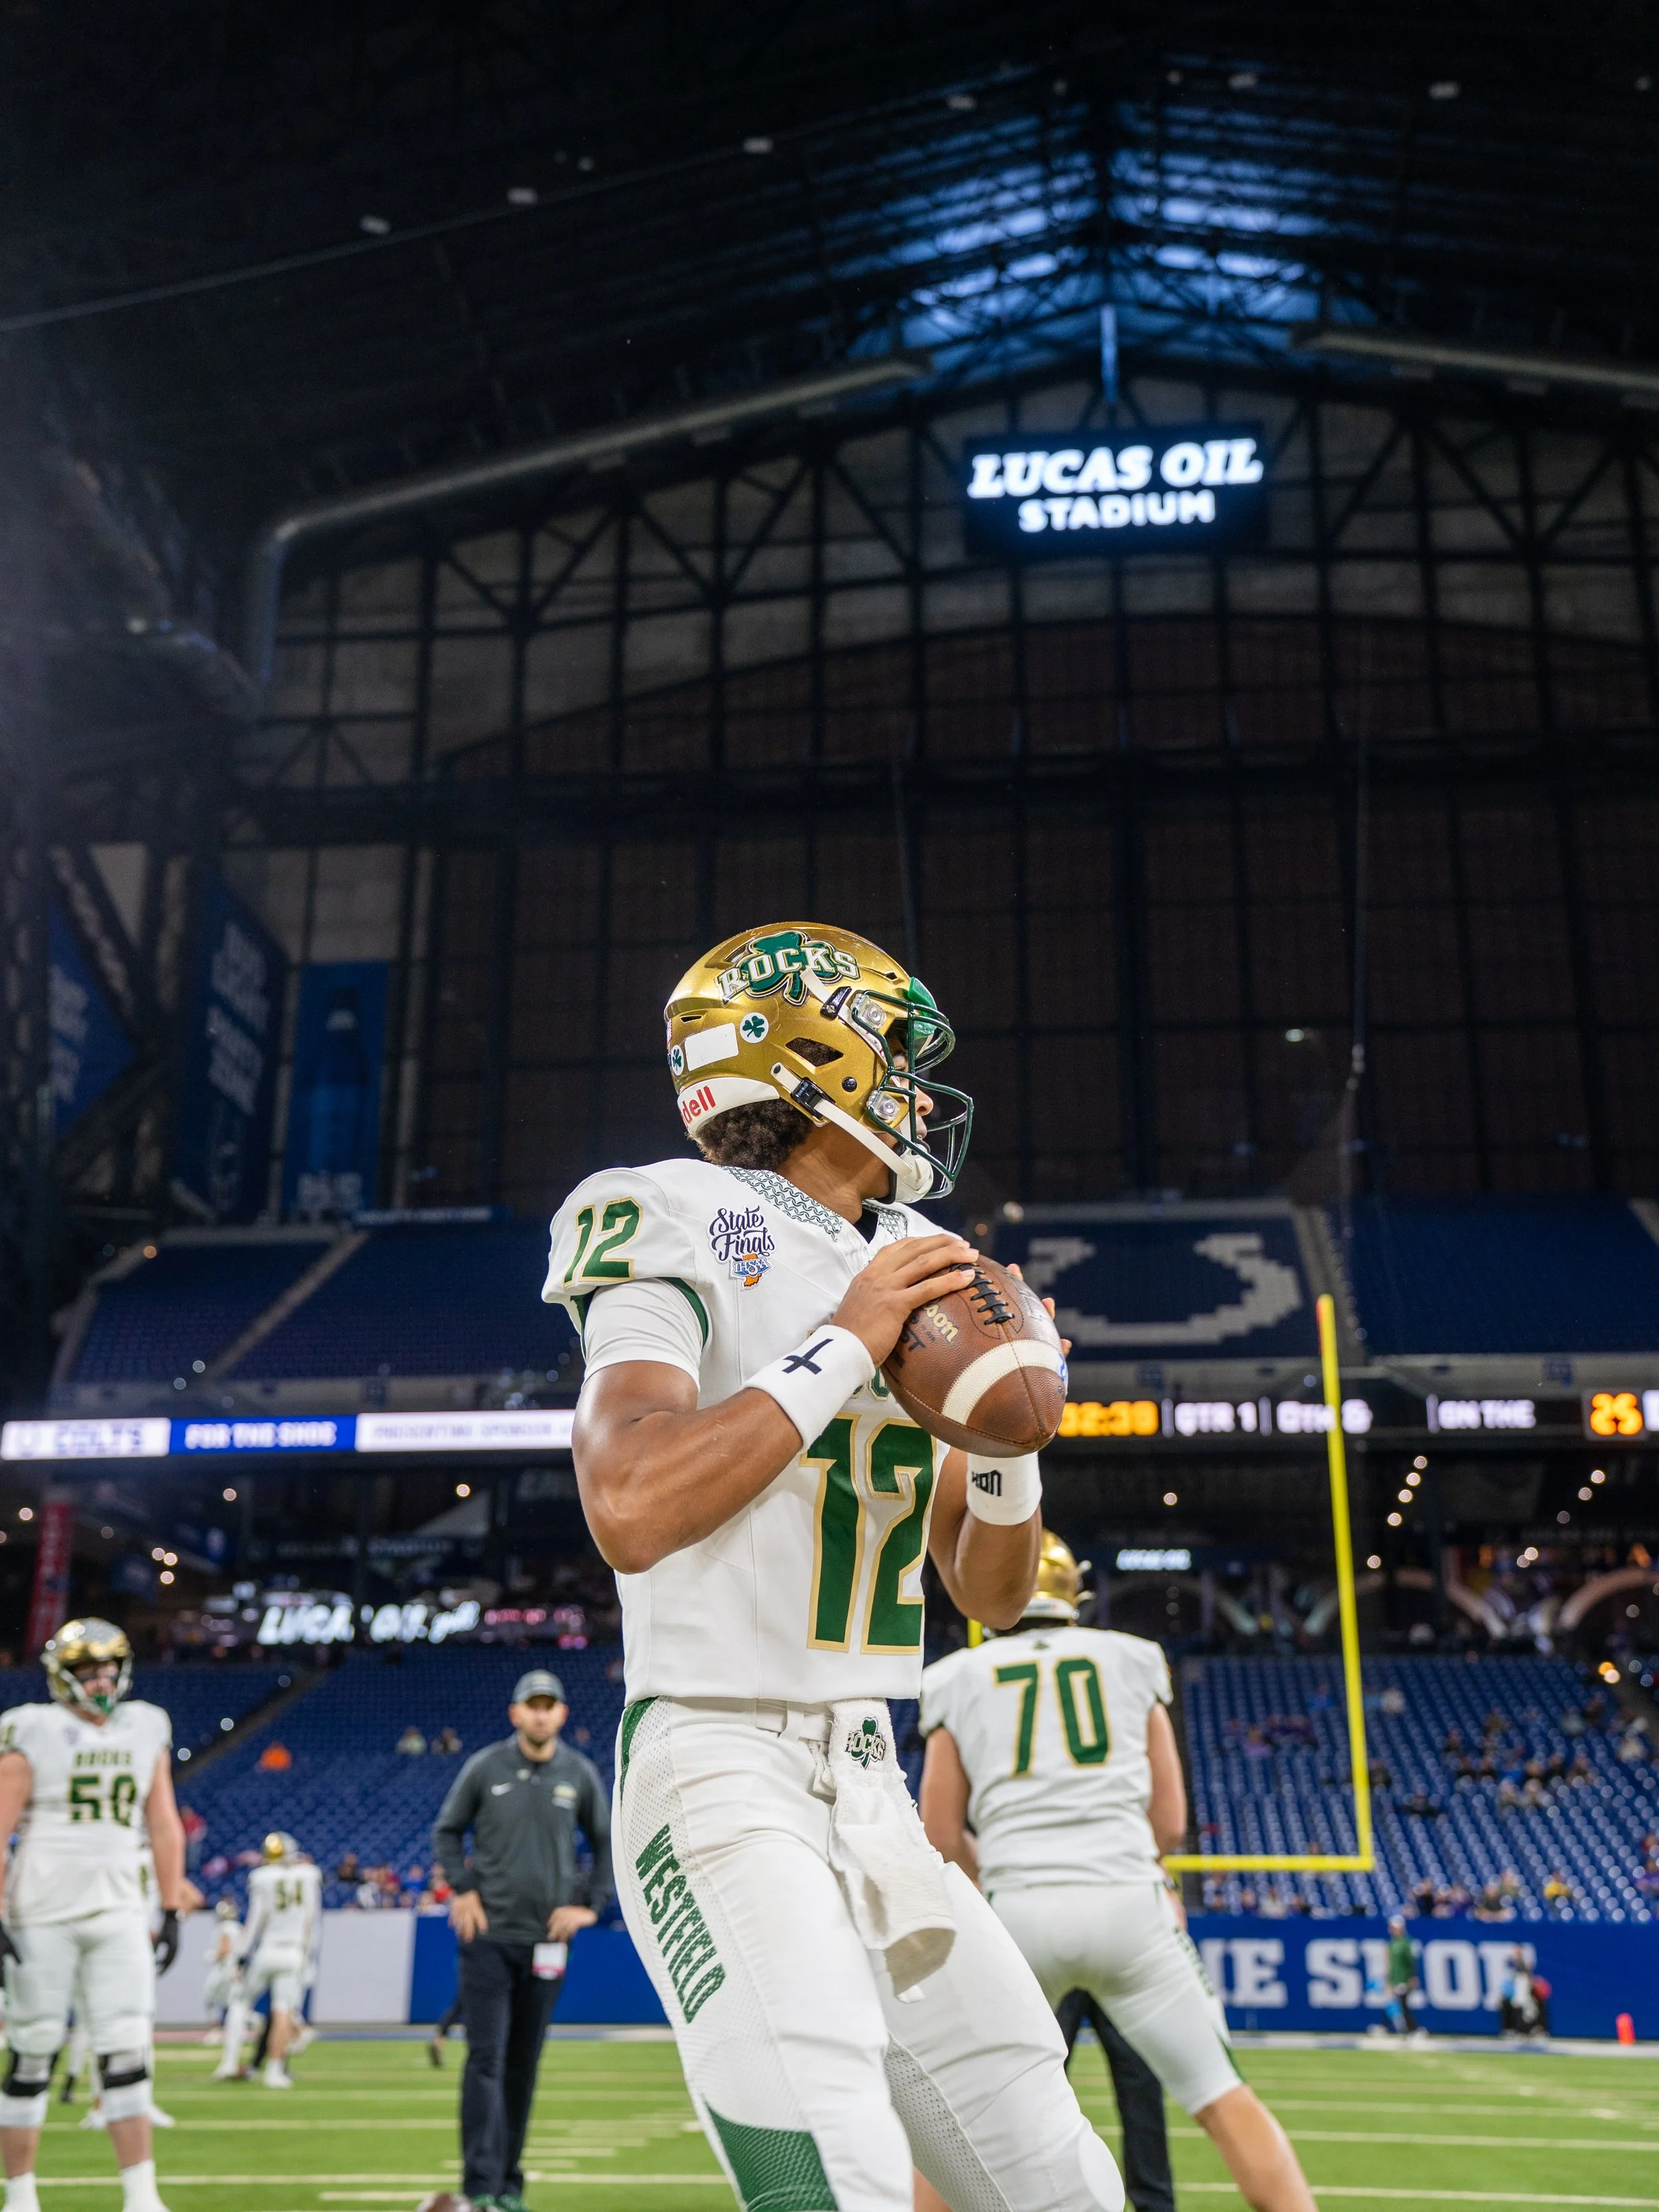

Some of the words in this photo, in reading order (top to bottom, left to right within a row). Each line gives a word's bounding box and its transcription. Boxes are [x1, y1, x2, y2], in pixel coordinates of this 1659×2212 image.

[967, 446, 1153, 498] LUCAS
[1160, 438, 1263, 487] OIL
[1019, 489, 1215, 532] STADIUM
[717, 946, 860, 1004] ROCKS
[681, 1085, 716, 1127] dell
[564, 1196, 643, 1288] 12
[709, 1205, 764, 1236] State
[711, 1226, 775, 1261] Finals
[733, 1258, 770, 1276] IHSAA
[1237, 1402, 1257, 1432] 1
[1590, 1393, 1643, 1435] 25
[798, 1410, 938, 1655] 12
[993, 1656, 1111, 1777] 70
[845, 1732, 885, 1761] ROCKS
[69, 1774, 137, 1827] 50
[636, 1823, 726, 2025] WESTFIELD
